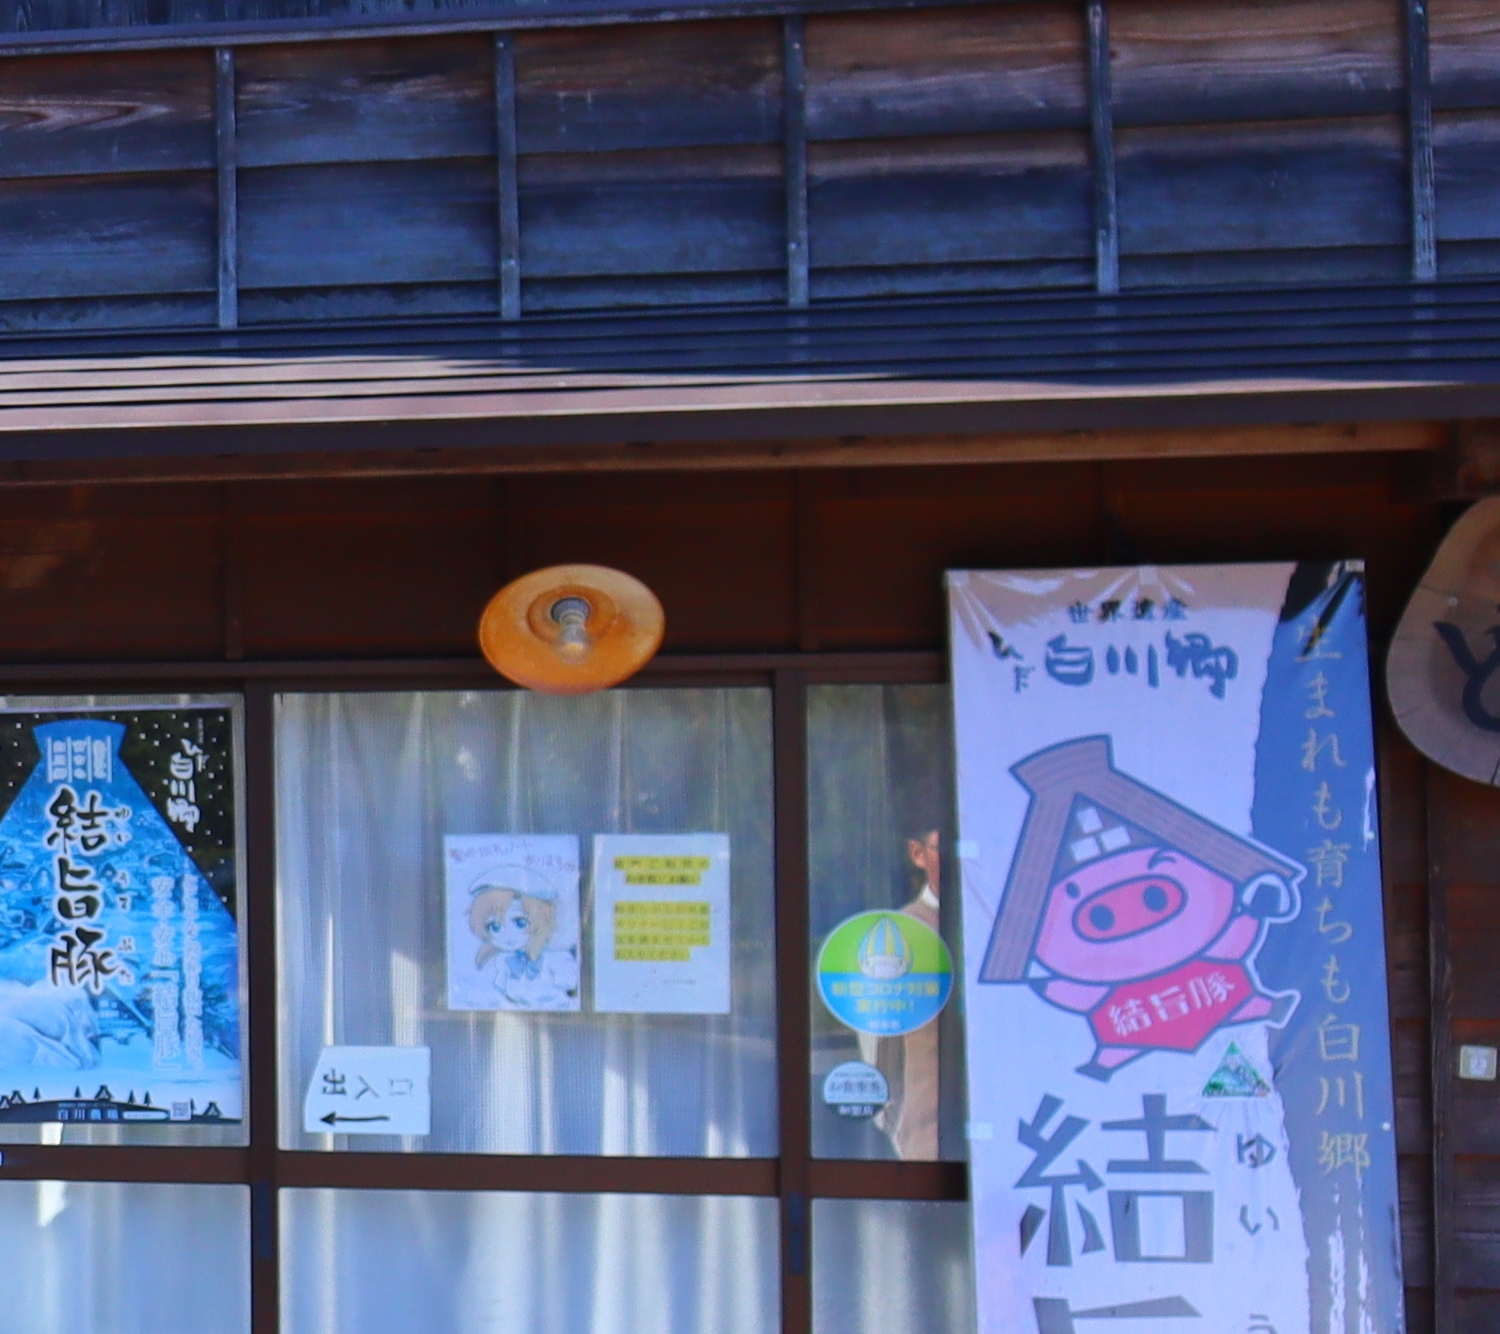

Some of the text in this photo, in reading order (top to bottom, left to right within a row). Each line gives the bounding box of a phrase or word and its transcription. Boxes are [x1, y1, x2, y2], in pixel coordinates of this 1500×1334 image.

[1045, 630, 1239, 700] 白川郷
[46, 787, 119, 990] 結旨豚
[322, 1067, 414, 1101] 出入口
